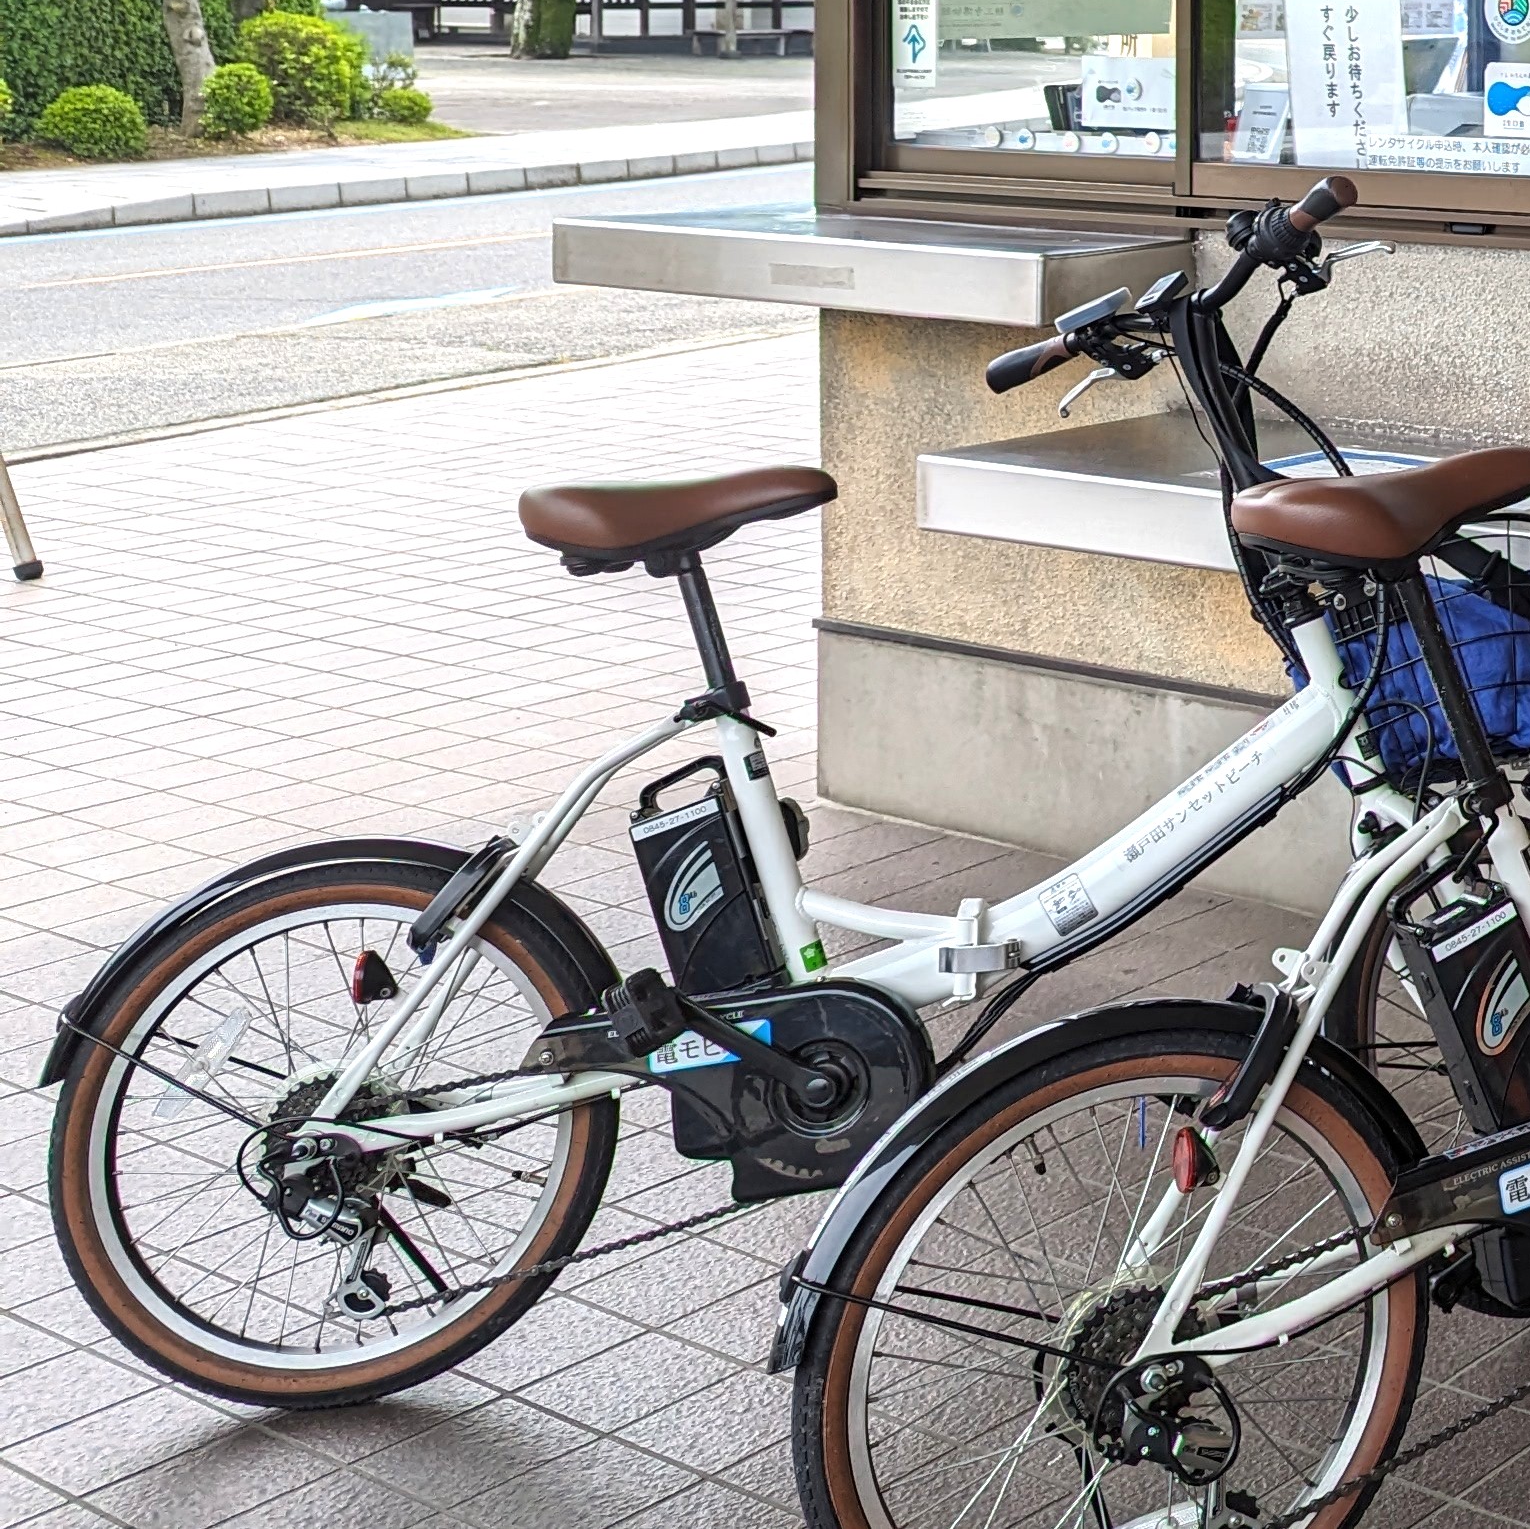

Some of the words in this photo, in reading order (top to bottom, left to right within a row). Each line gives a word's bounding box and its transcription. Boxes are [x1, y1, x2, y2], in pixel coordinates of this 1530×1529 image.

[1321, 5, 1340, 117] すぐ戻ります
[644, 806, 706, 834] 0845-27-1100
[1123, 750, 1265, 863] 瀬戸田サンセットビーチ
[1445, 911, 1506, 952] 0845-27-1100
[1453, 1164, 1499, 1185] ELECTRIC
